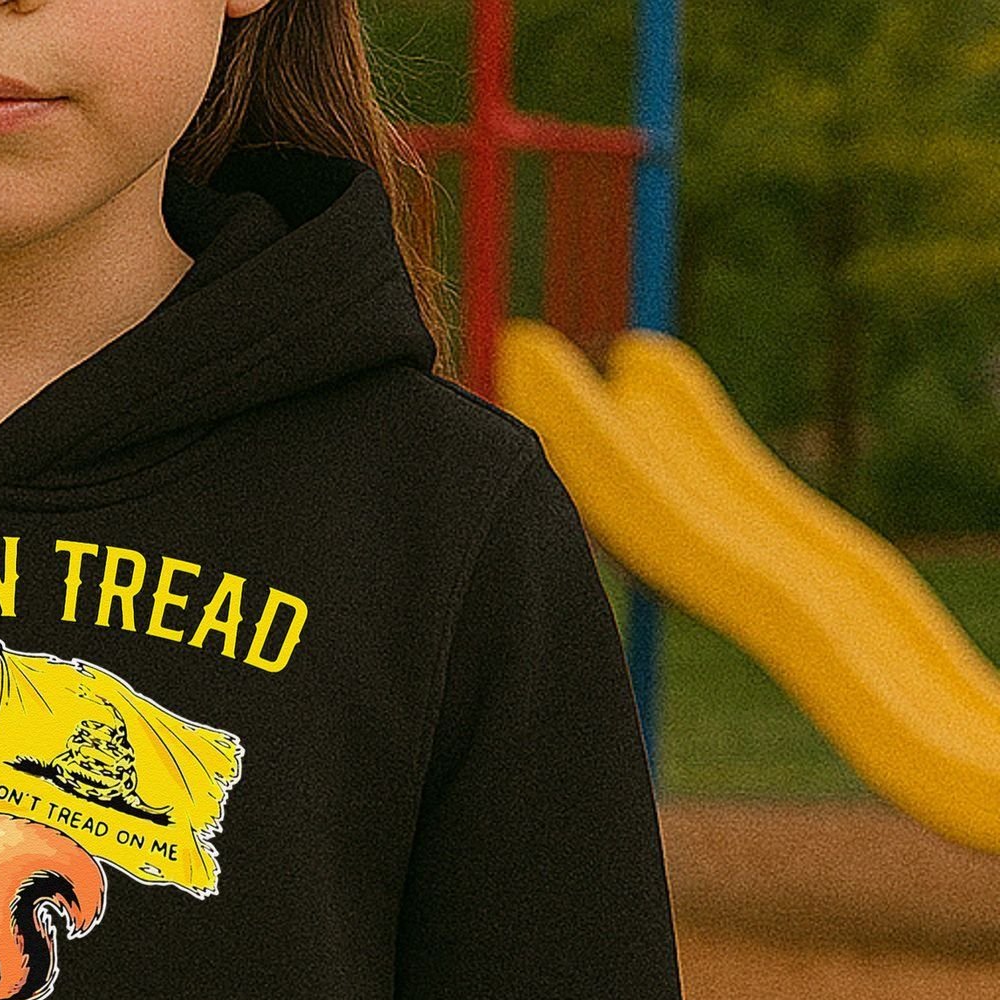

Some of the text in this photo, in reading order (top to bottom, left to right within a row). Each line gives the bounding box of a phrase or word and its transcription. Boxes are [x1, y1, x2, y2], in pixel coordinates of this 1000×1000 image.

[54, 540, 309, 673] TREAD
[47, 803, 108, 837] TREAD
[117, 831, 144, 849] ON
[151, 840, 178, 861] ME
